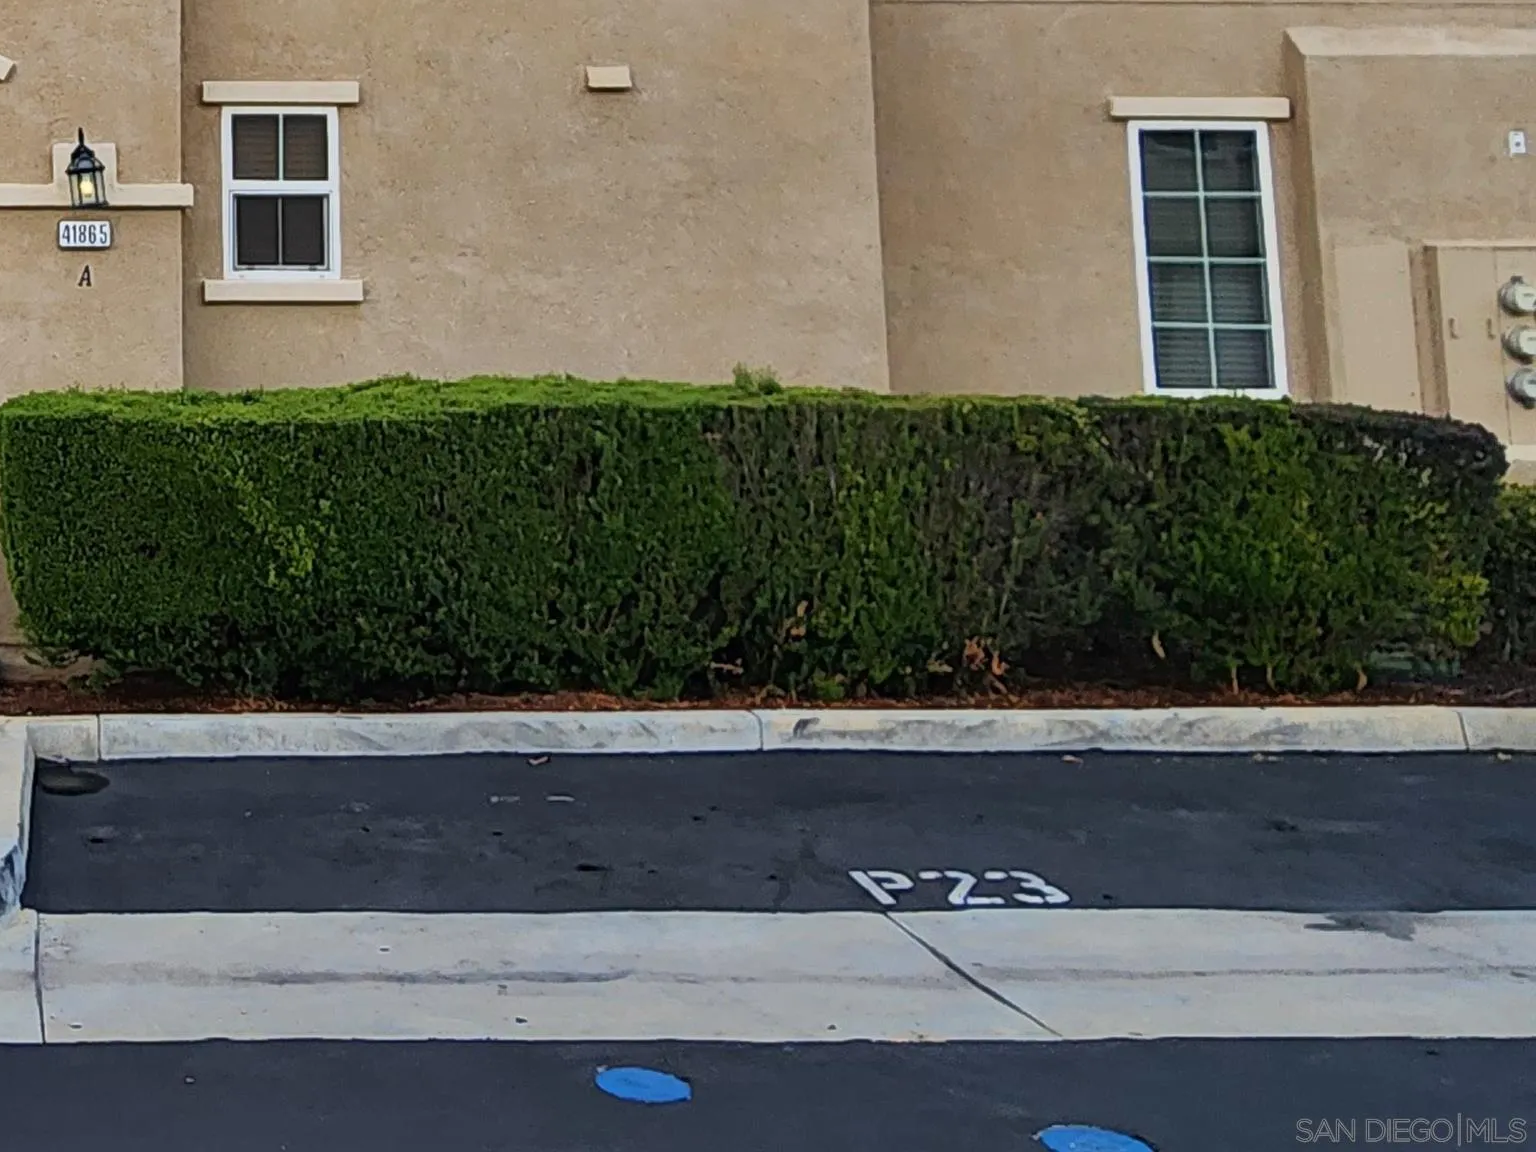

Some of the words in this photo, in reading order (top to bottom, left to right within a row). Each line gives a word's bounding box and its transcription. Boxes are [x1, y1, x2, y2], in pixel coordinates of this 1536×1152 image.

[61, 223, 108, 245] 41865
[77, 264, 92, 287] A
[848, 870, 1070, 905] P23
